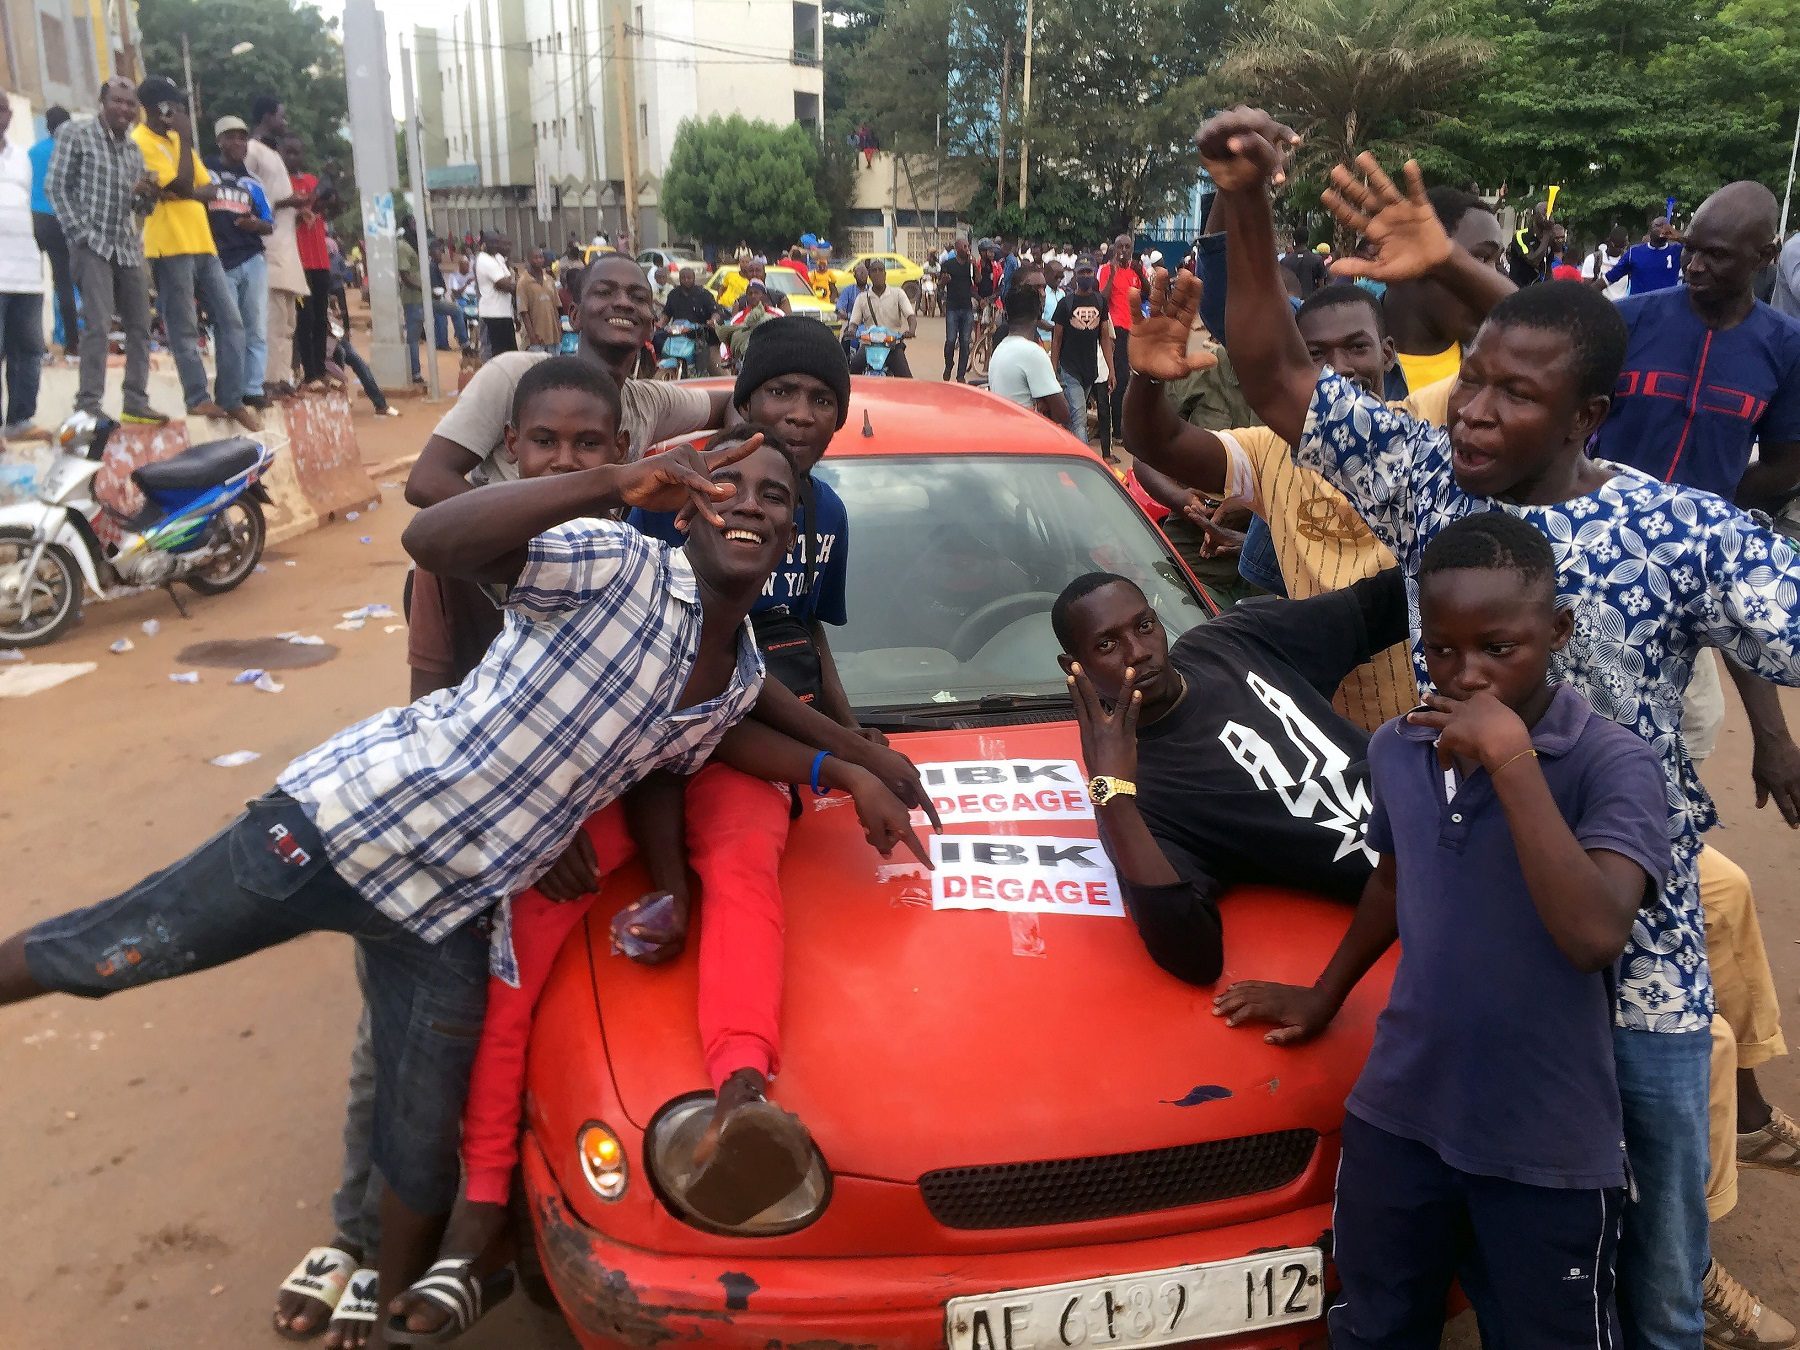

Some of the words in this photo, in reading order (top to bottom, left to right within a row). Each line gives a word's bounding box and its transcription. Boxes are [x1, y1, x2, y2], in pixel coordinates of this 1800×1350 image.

[925, 764, 1074, 785] IBK
[932, 789, 1086, 815] DEGAGE
[940, 842, 1103, 869] IBK
[942, 875, 1112, 906] DEGAGE
[1059, 1280, 1188, 1346] 6189
